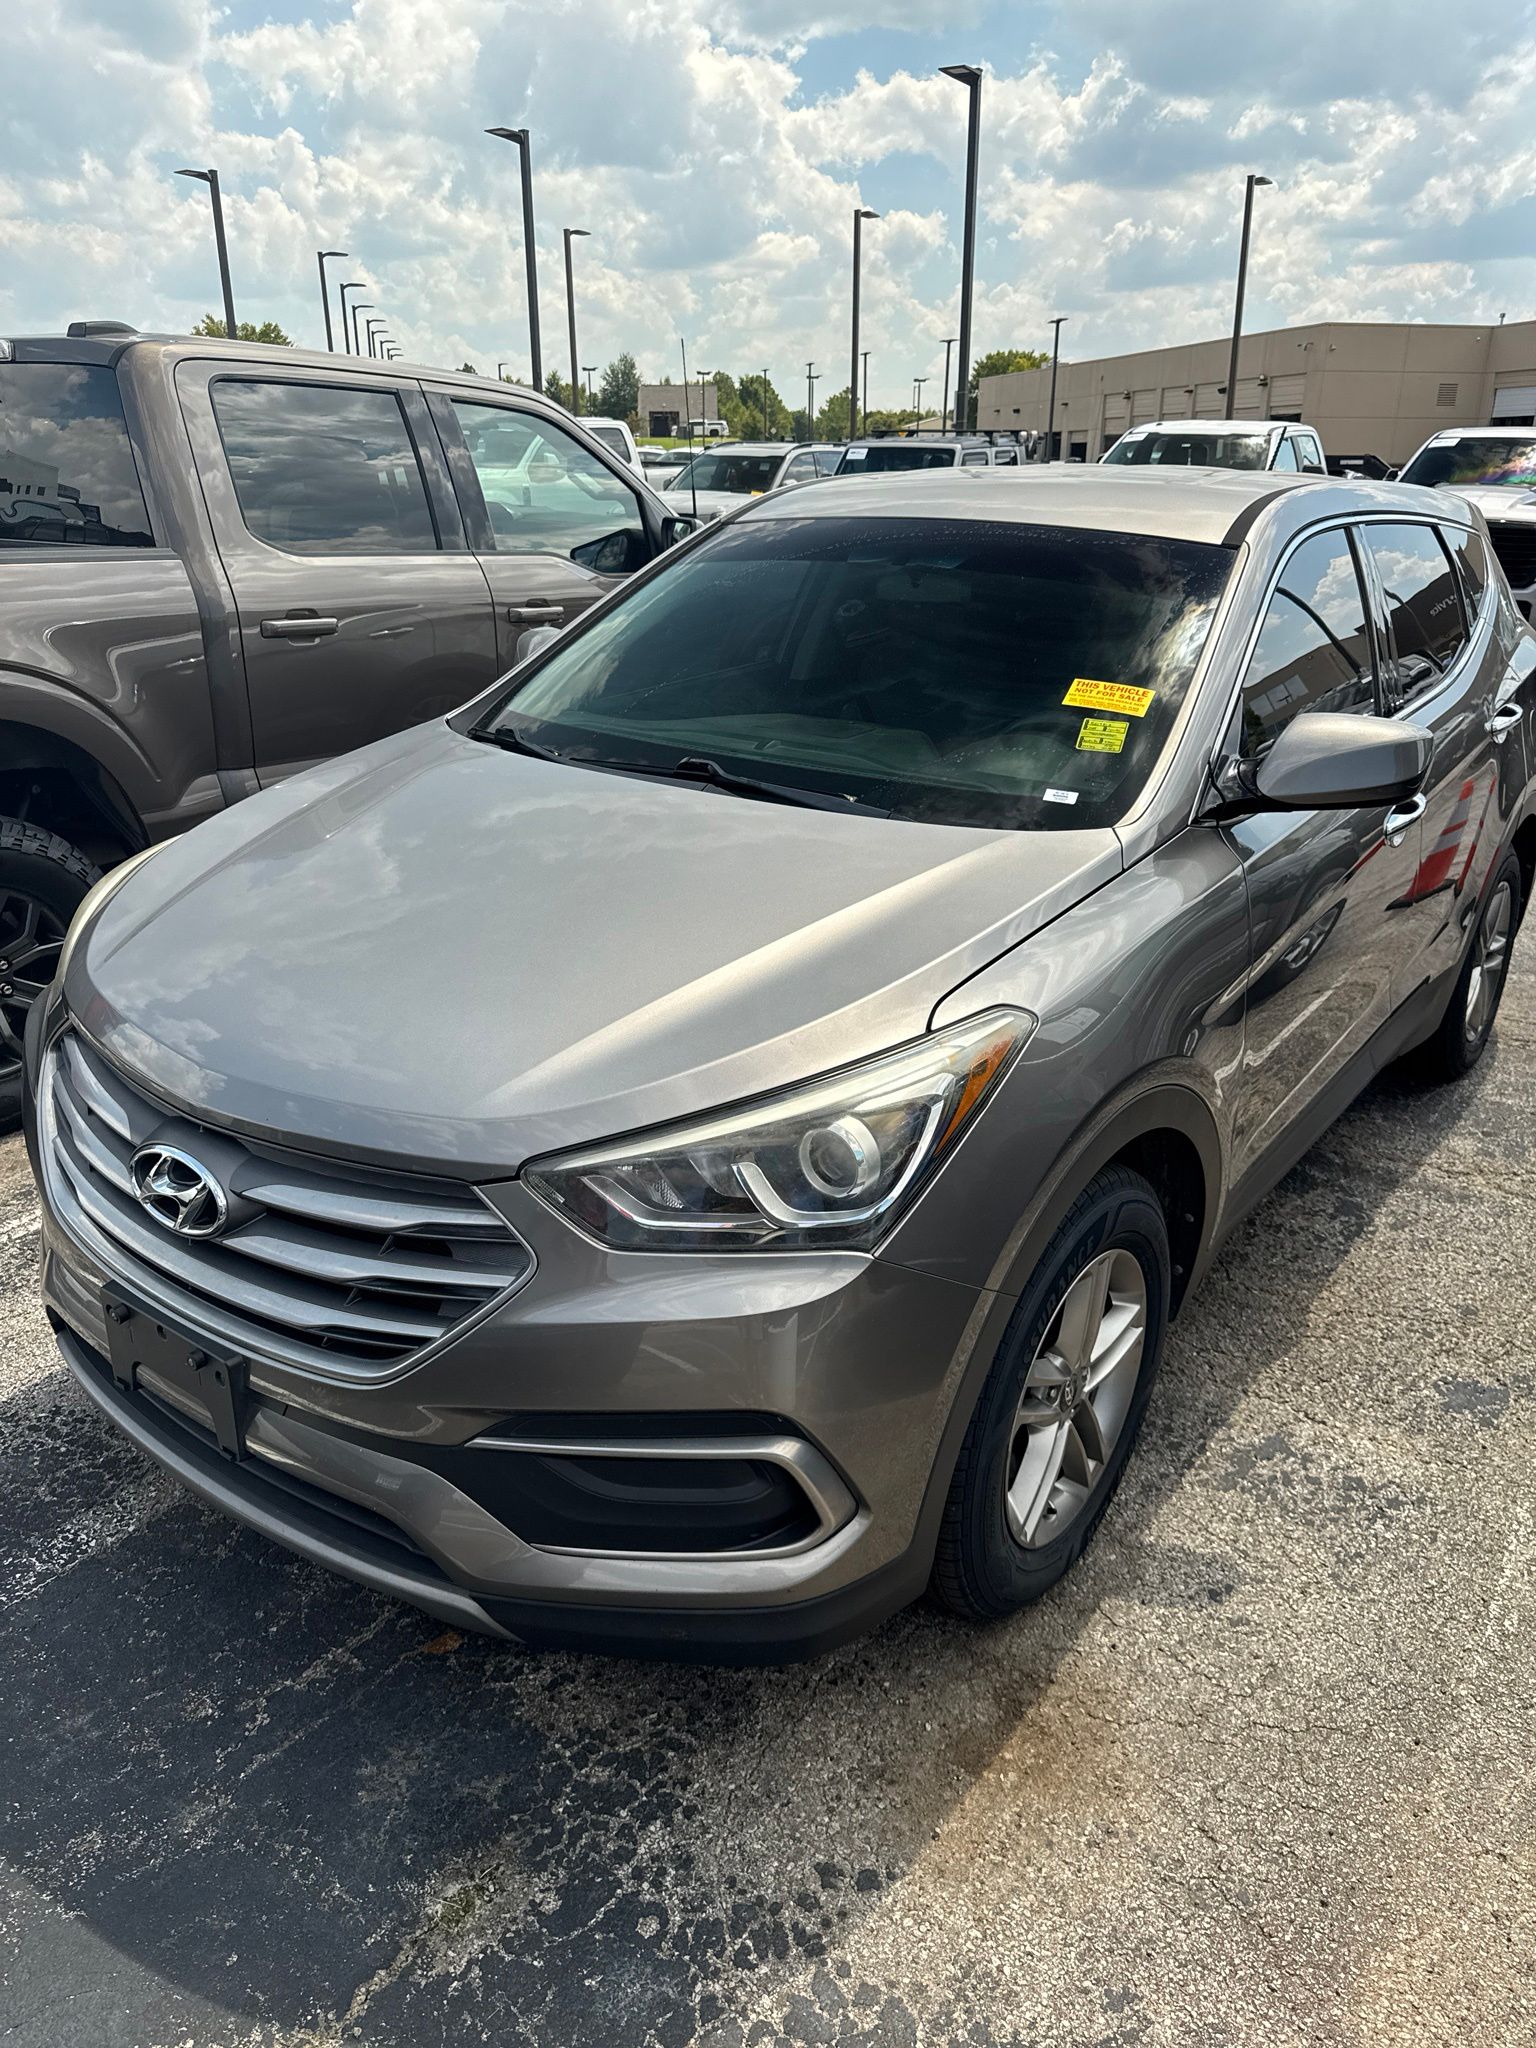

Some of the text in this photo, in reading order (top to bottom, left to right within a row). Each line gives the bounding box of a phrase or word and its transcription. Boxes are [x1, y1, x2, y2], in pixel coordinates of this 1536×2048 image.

[1074, 687, 1145, 703] NOT FOR SALE
[1076, 680, 1151, 698] THIS VEHICLE
